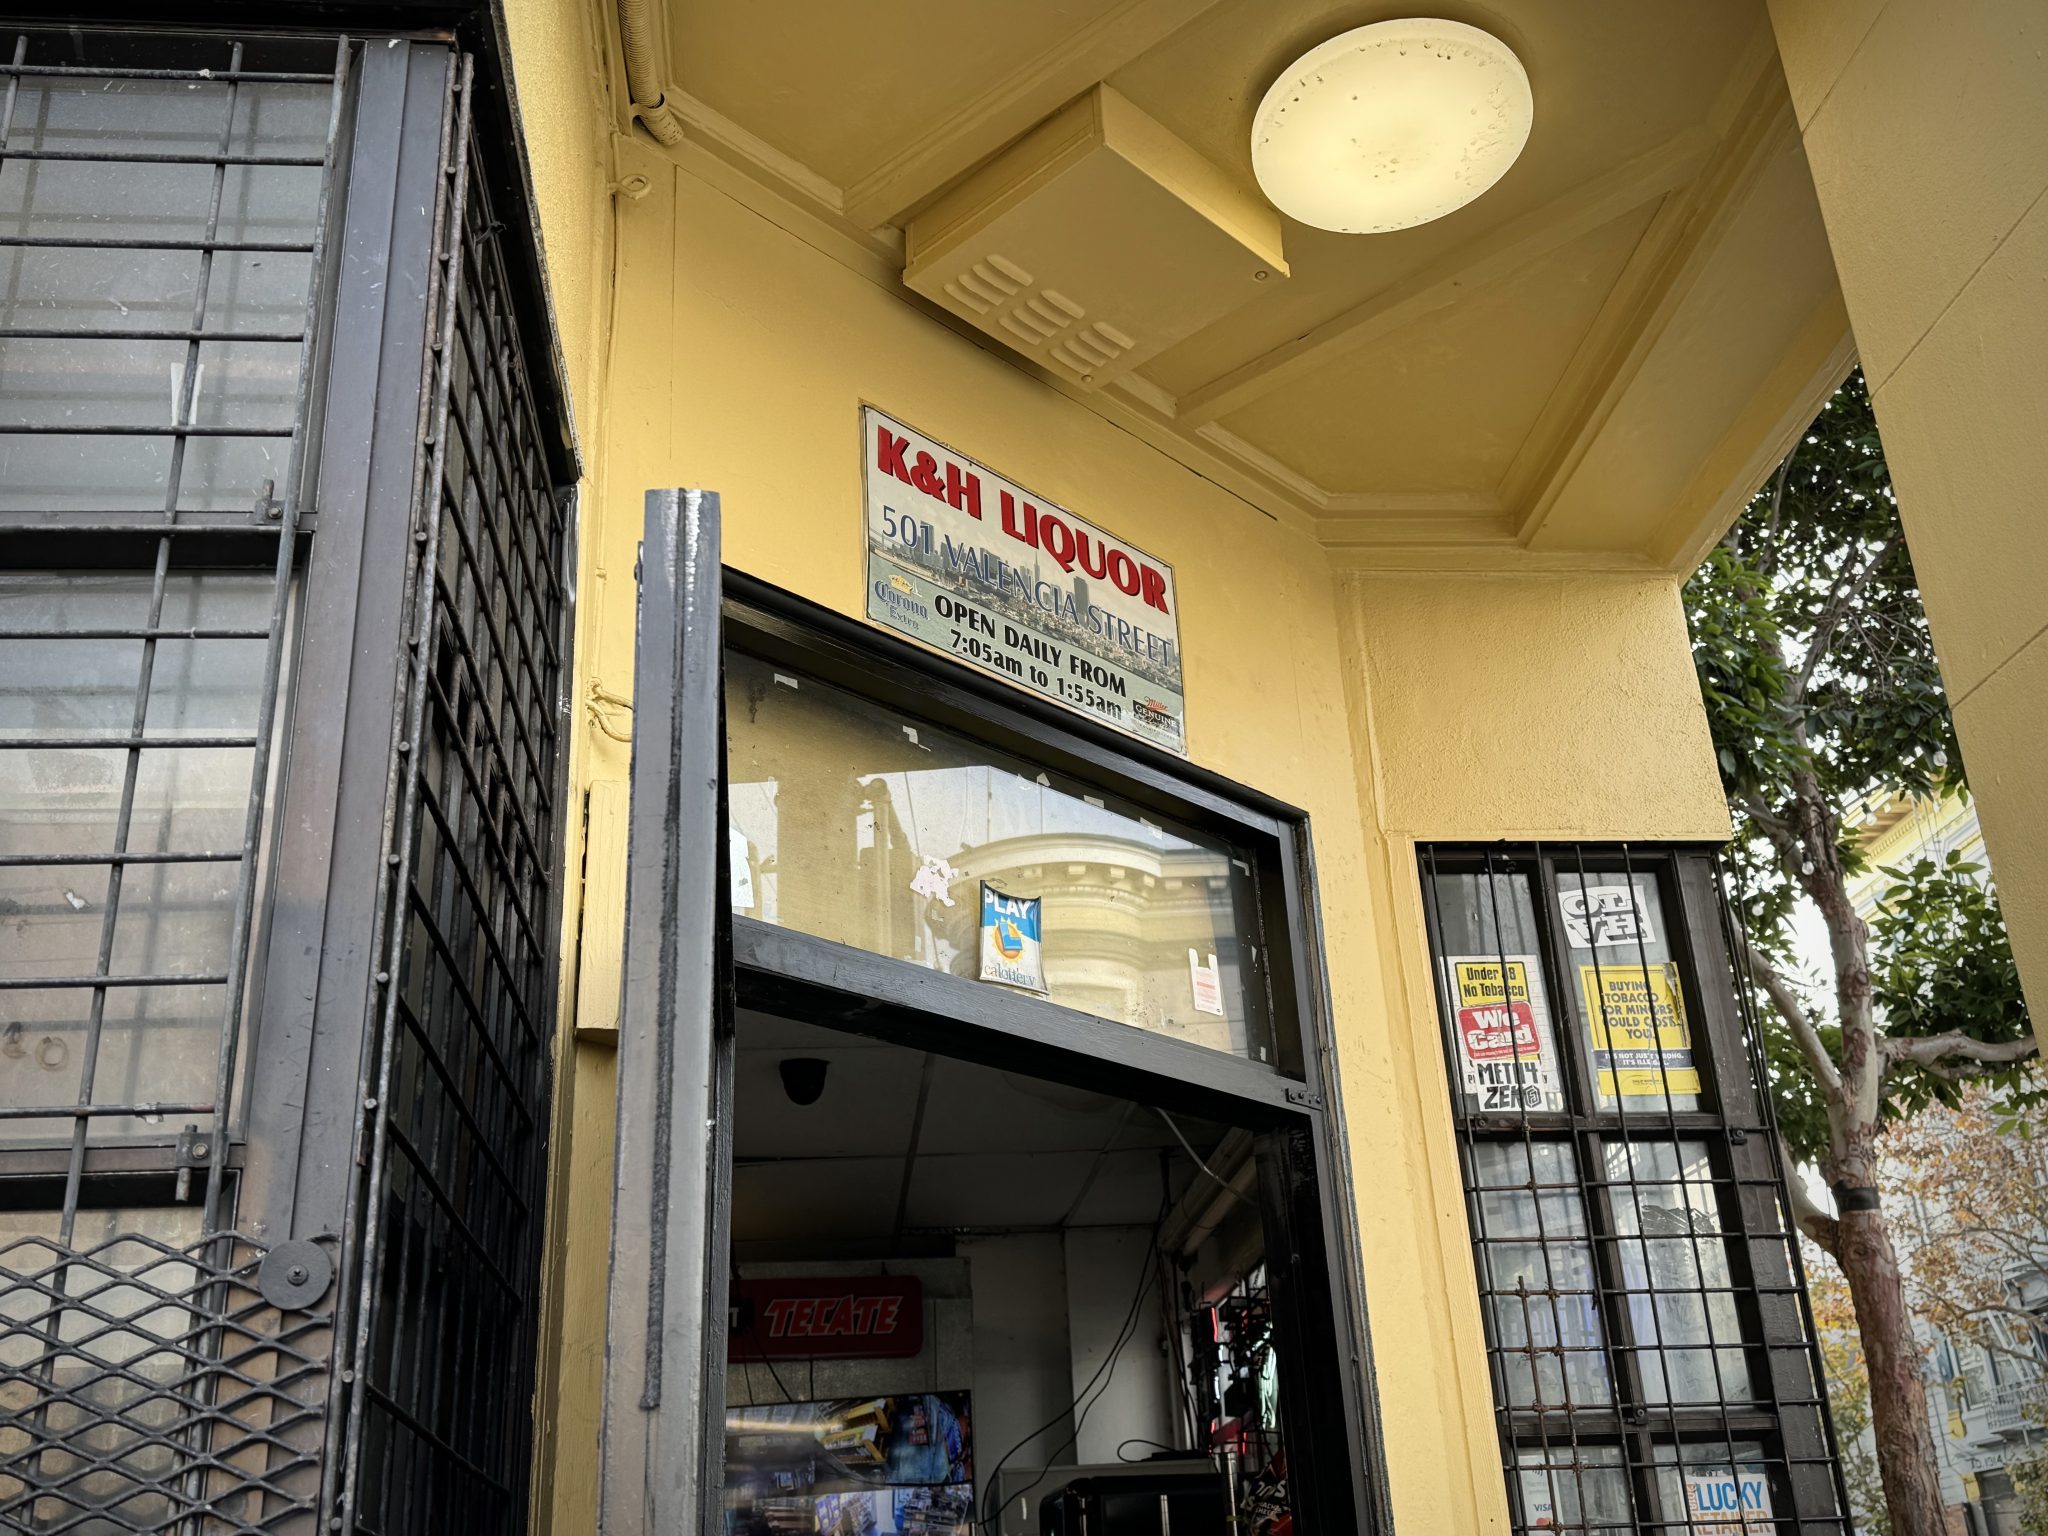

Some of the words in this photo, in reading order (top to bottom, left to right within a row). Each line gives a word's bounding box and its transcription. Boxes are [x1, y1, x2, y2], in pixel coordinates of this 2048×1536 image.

[877, 425, 982, 521] K&H
[1000, 488, 1170, 615] LIQUOR
[874, 580, 930, 620] Corona
[882, 504, 932, 556] 501
[944, 533, 1080, 626] VALENCIA
[1088, 604, 1172, 667] STREET
[934, 594, 996, 639] OPEN
[1004, 624, 1063, 668] DAILY
[1069, 654, 1127, 698] FROM
[949, 628, 1023, 678] 7:05am
[1029, 665, 1049, 688] to
[1056, 677, 1122, 721] 1:55am
[1135, 704, 1179, 728] GENUINE
[984, 887, 1032, 920] PLAY
[1463, 983, 1478, 998] No
[1466, 967, 1499, 981] Under
[1472, 1009, 1520, 1030] We
[1603, 1017, 1641, 1028] OULD
[1467, 1024, 1535, 1051] Card
[764, 1294, 903, 1338] TECATE
